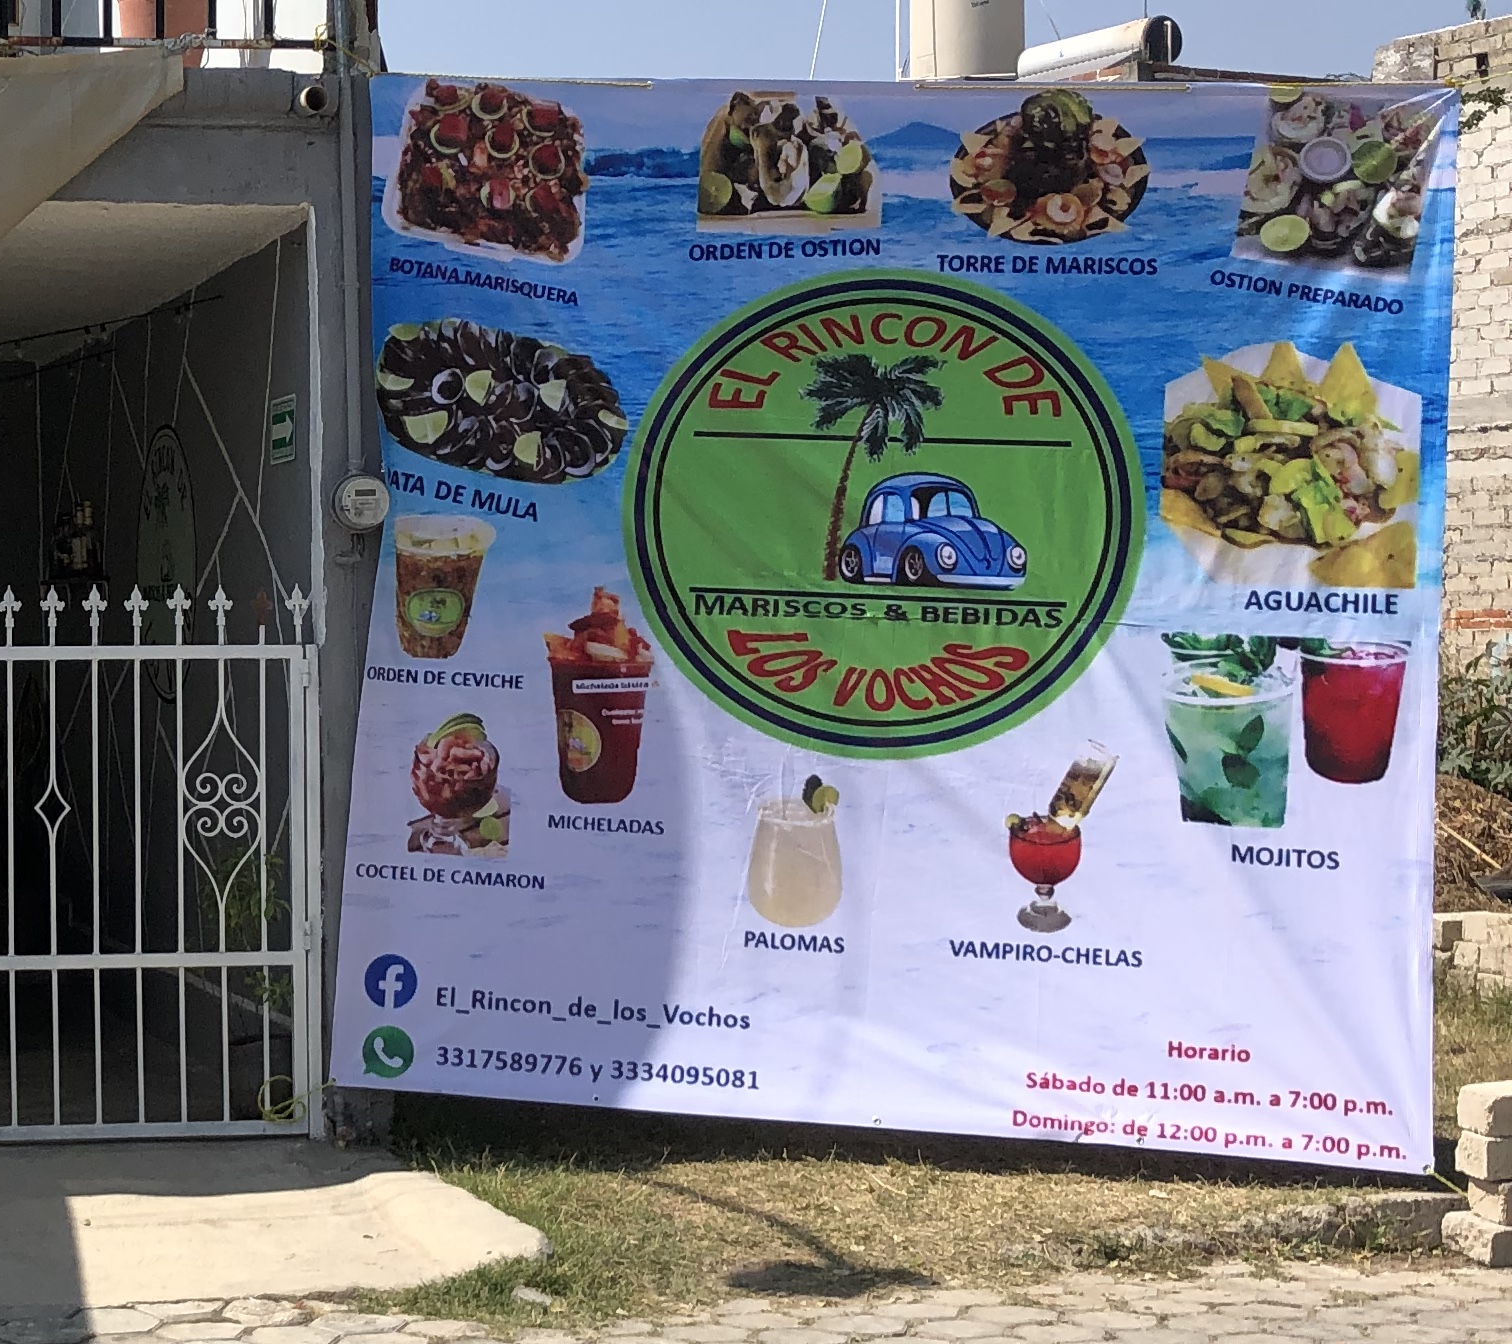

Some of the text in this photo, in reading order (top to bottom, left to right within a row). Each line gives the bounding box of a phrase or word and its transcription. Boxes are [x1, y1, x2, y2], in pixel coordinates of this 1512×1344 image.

[689, 238, 881, 262] ORDEN DE OSTION
[937, 254, 1158, 276] TORRE DE MARISCOS
[389, 257, 578, 306] BOTANA MARISQUERA
[1210, 269, 1404, 315] OSTION PREPARADO
[708, 312, 1062, 418] EL RINCON DE
[434, 479, 467, 505] DE
[470, 488, 538, 522] MULA
[694, 594, 1063, 629] MARISCOS & BEBIDAS
[1245, 590, 1398, 615] AGUACHILE
[367, 666, 524, 690] ORDEN DE CEVICHE
[727, 629, 1030, 712] LOS VOCHOS
[548, 814, 665, 836] MICHELADAS
[1231, 844, 1340, 870] MOJITOS
[356, 863, 545, 890] COCTEL DE CAMARON
[743, 930, 845, 954] PALOMAS
[949, 939, 1143, 968] VAMPIRO-CHELAS
[436, 986, 751, 1030] El_Rincon_de_los_Vochos
[1167, 1040, 1251, 1063] Horario
[436, 1046, 759, 1090] 3317589776 y 3334095081
[1026, 1071, 1393, 1116] Sábado de 11:00 a.m. a 7:00 p.m.
[1012, 1109, 1407, 1160] Domingo: de 12:00 p.m. a 7:00 p.m.
